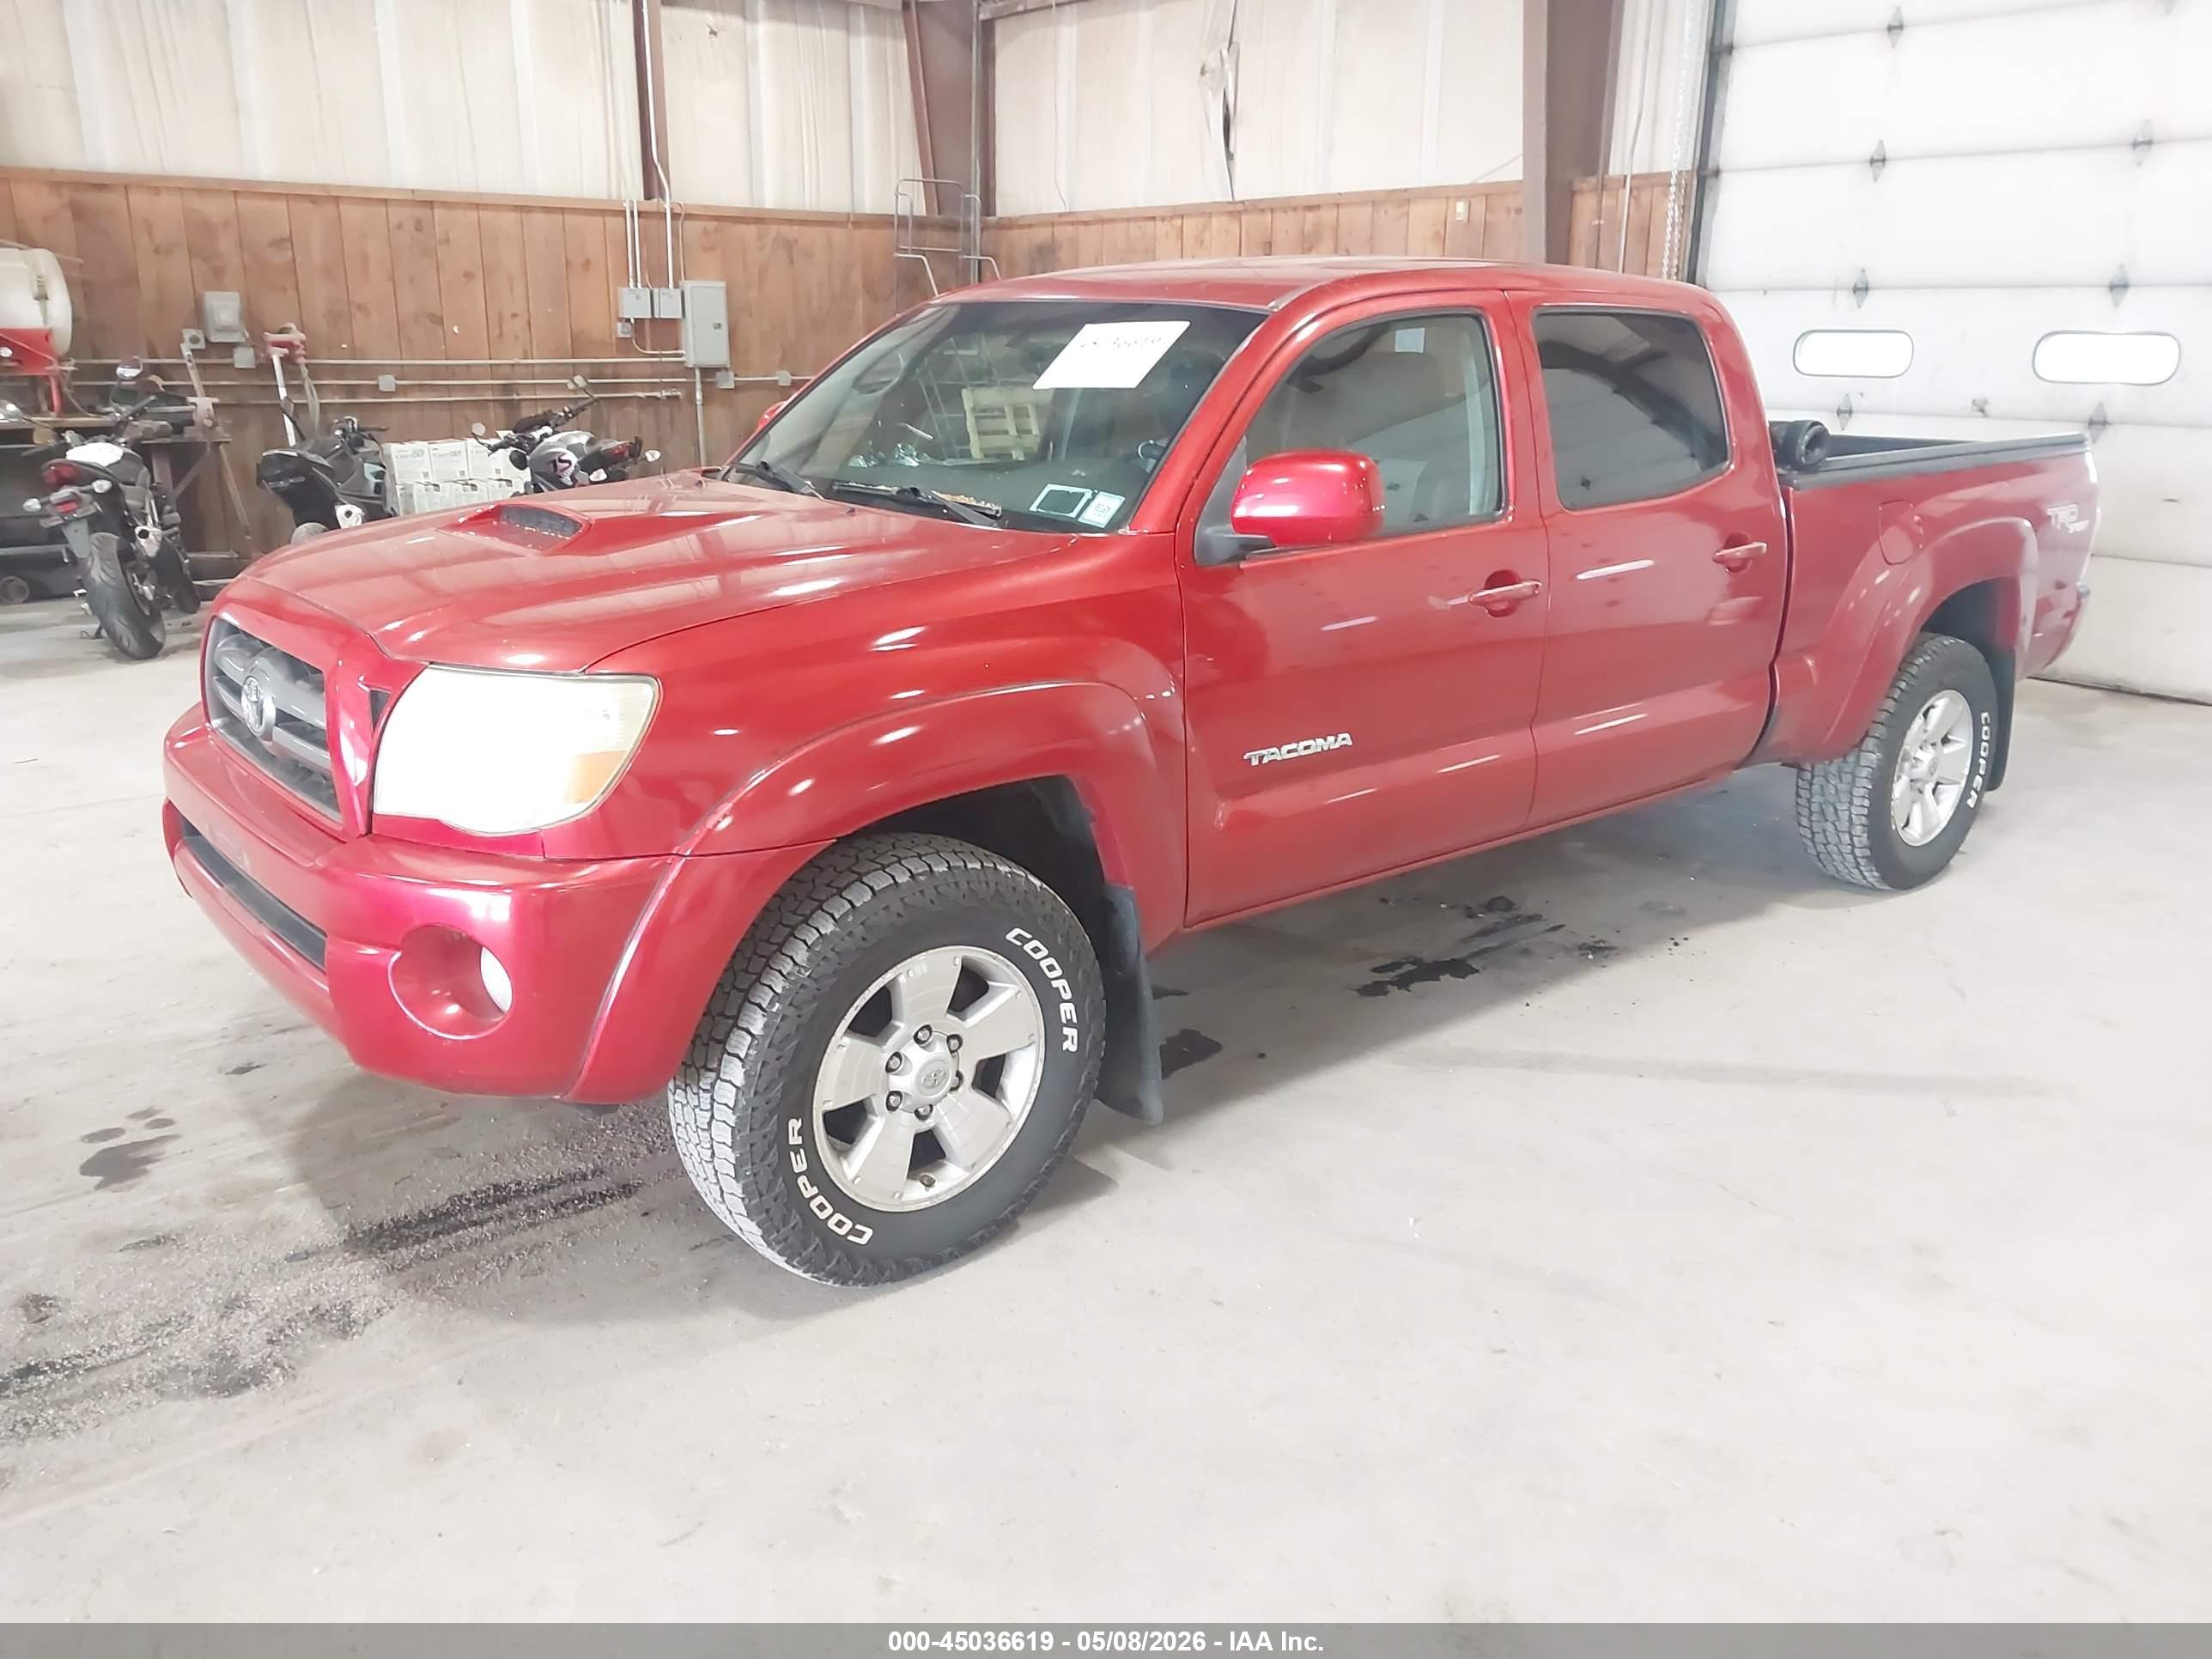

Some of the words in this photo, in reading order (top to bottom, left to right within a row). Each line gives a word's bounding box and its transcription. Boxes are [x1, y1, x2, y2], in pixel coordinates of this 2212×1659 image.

[1243, 733, 1352, 766] TACOMA
[1967, 712, 1990, 809] COOPER
[1006, 927, 1079, 1052] COOPER
[788, 1118, 872, 1244] COOPER
